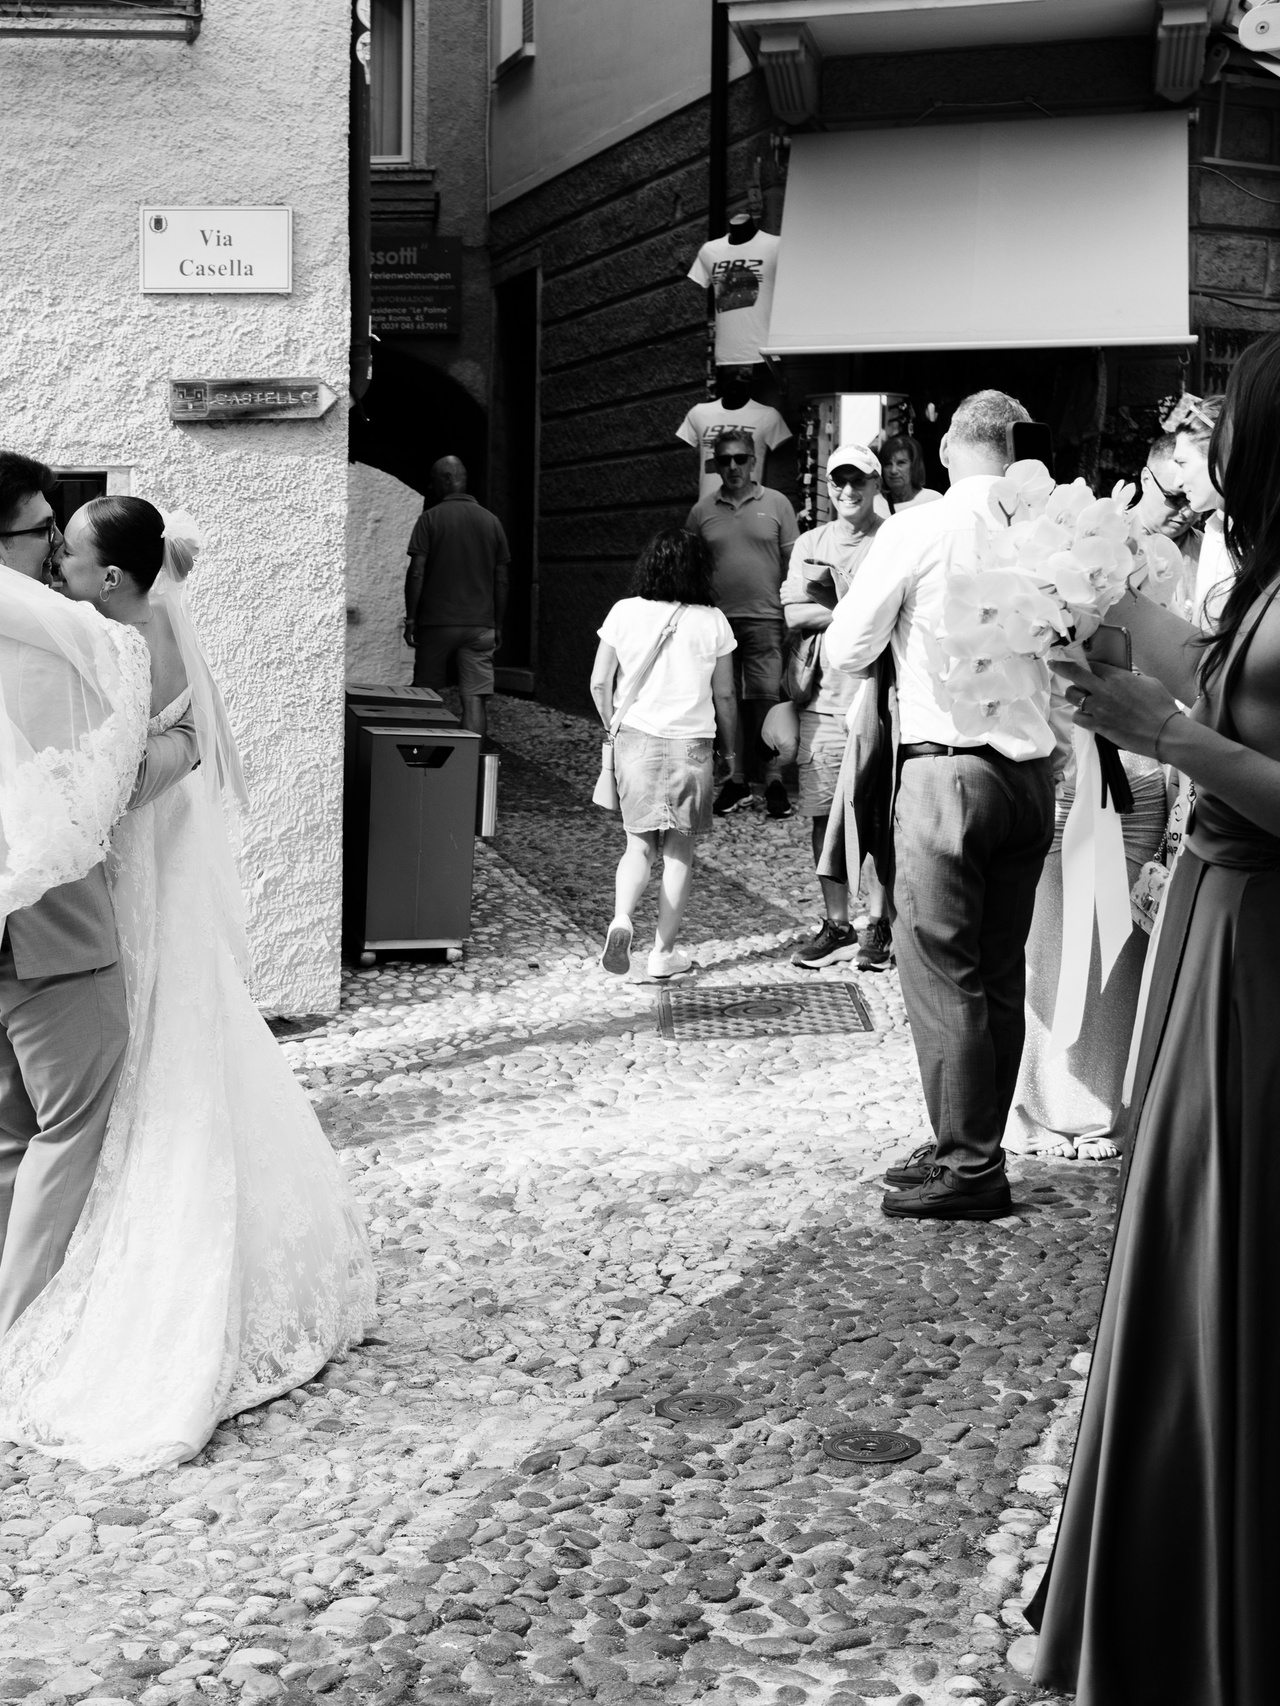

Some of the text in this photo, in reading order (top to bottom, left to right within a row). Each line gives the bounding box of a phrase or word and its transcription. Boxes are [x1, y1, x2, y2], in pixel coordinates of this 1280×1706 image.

[199, 229, 233, 247] Via
[178, 258, 254, 277] Casella
[711, 259, 764, 276] 1982
[371, 306, 407, 314] esidence
[372, 314, 386, 322] iale
[414, 314, 425, 322] 45
[213, 391, 314, 405] CASTELLO
